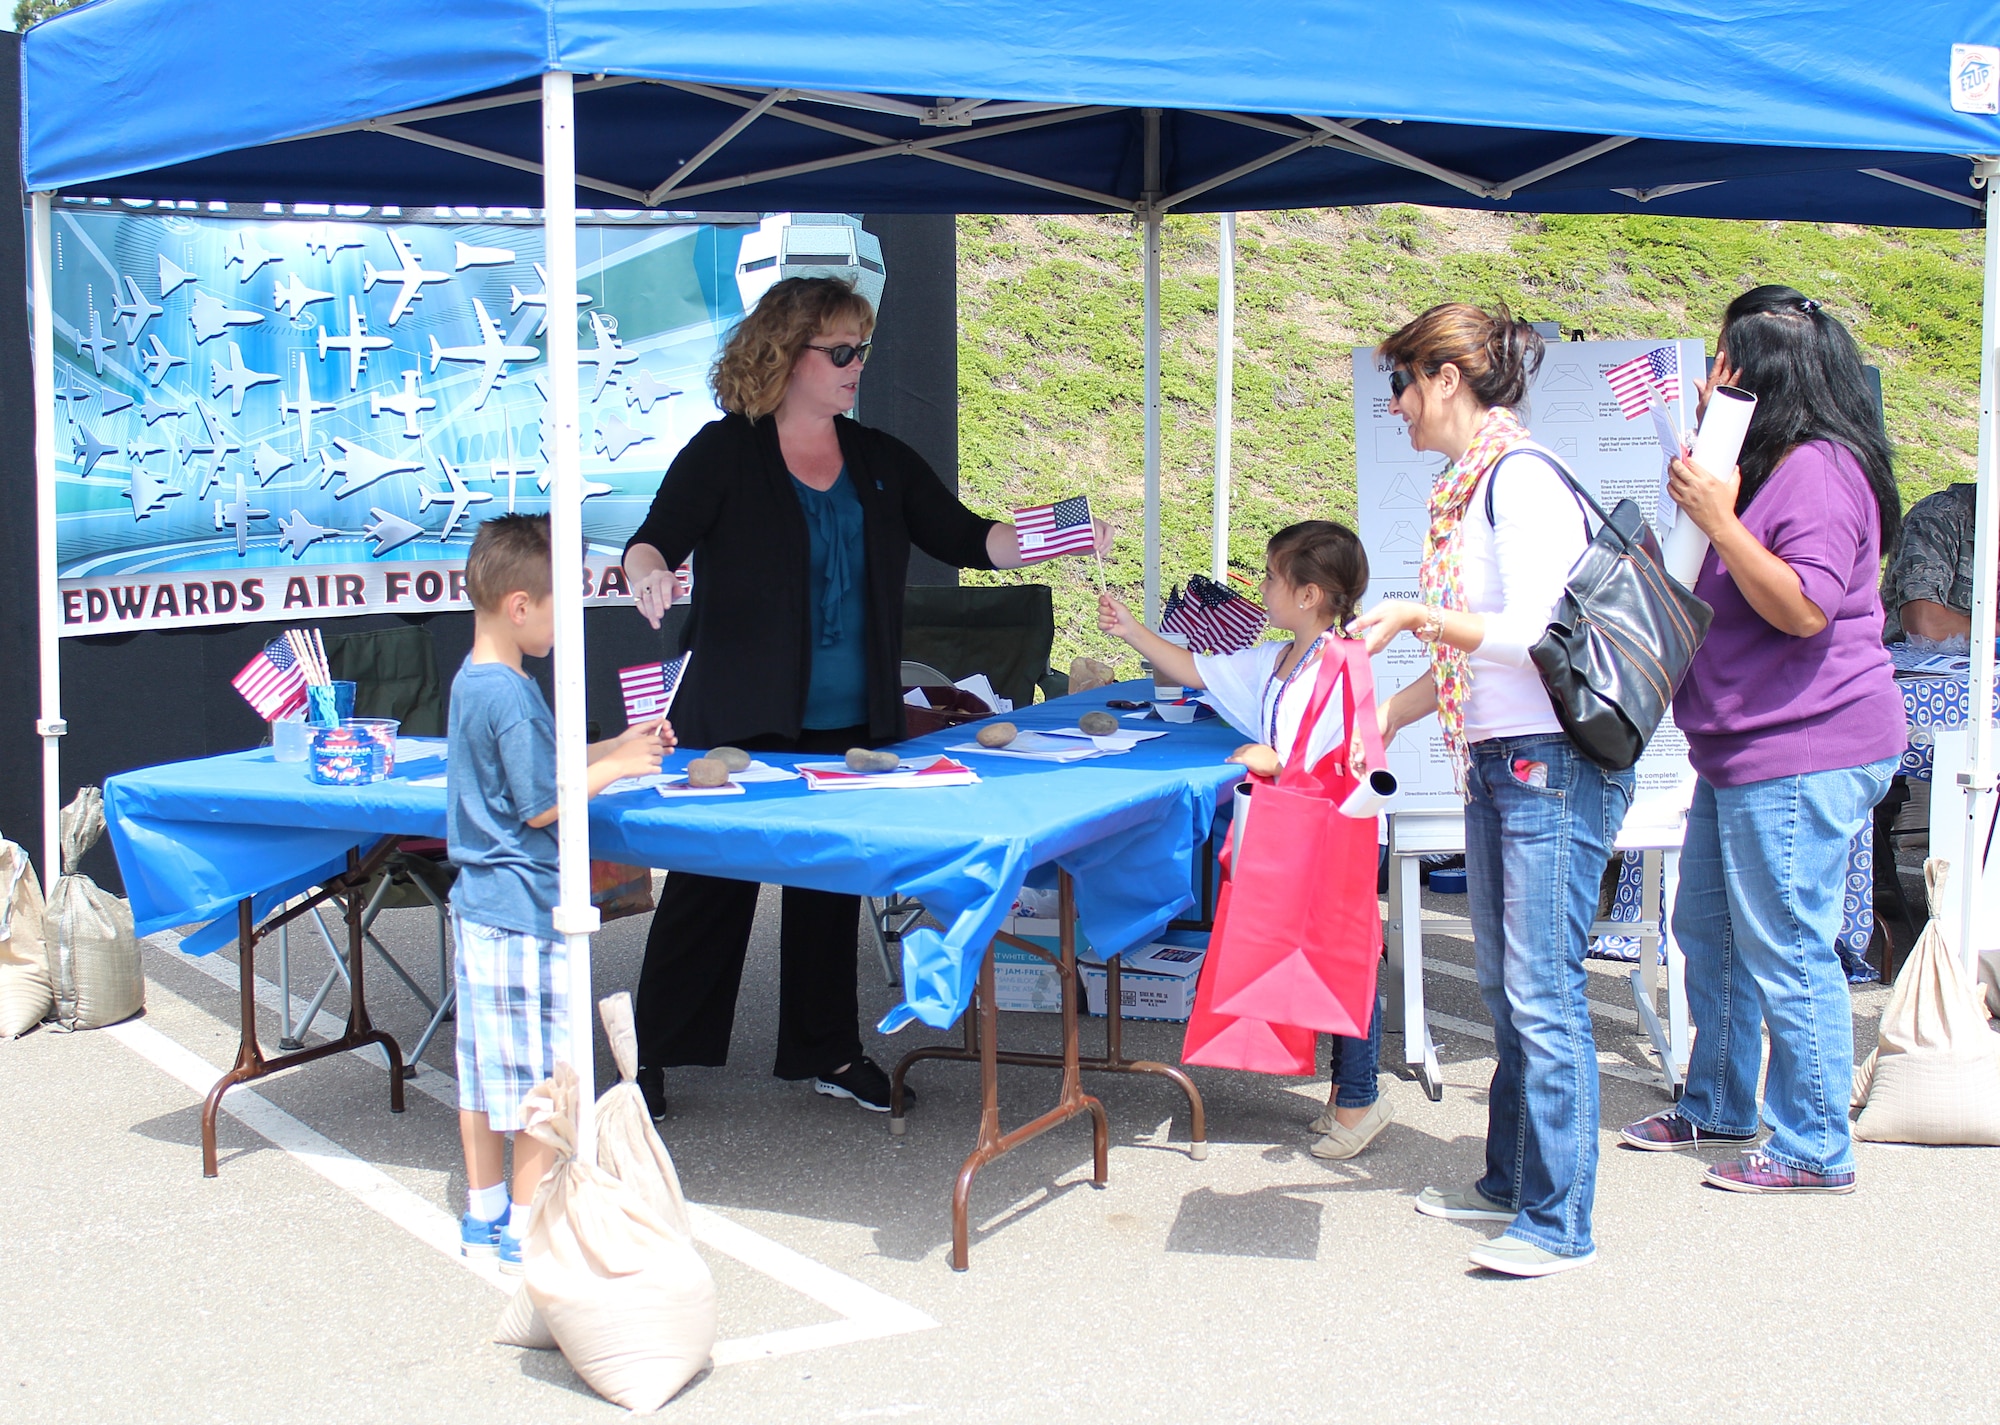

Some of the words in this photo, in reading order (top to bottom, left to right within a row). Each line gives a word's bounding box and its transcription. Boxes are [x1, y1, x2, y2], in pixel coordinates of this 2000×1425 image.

[61, 577, 265, 625] EDWARDS
[282, 573, 367, 610] AIR
[383, 569, 471, 605] FOR
[1383, 590, 1420, 600] ARROW
[1644, 771, 1679, 780] complete!
[1005, 967, 1045, 977] JAM-FREE
